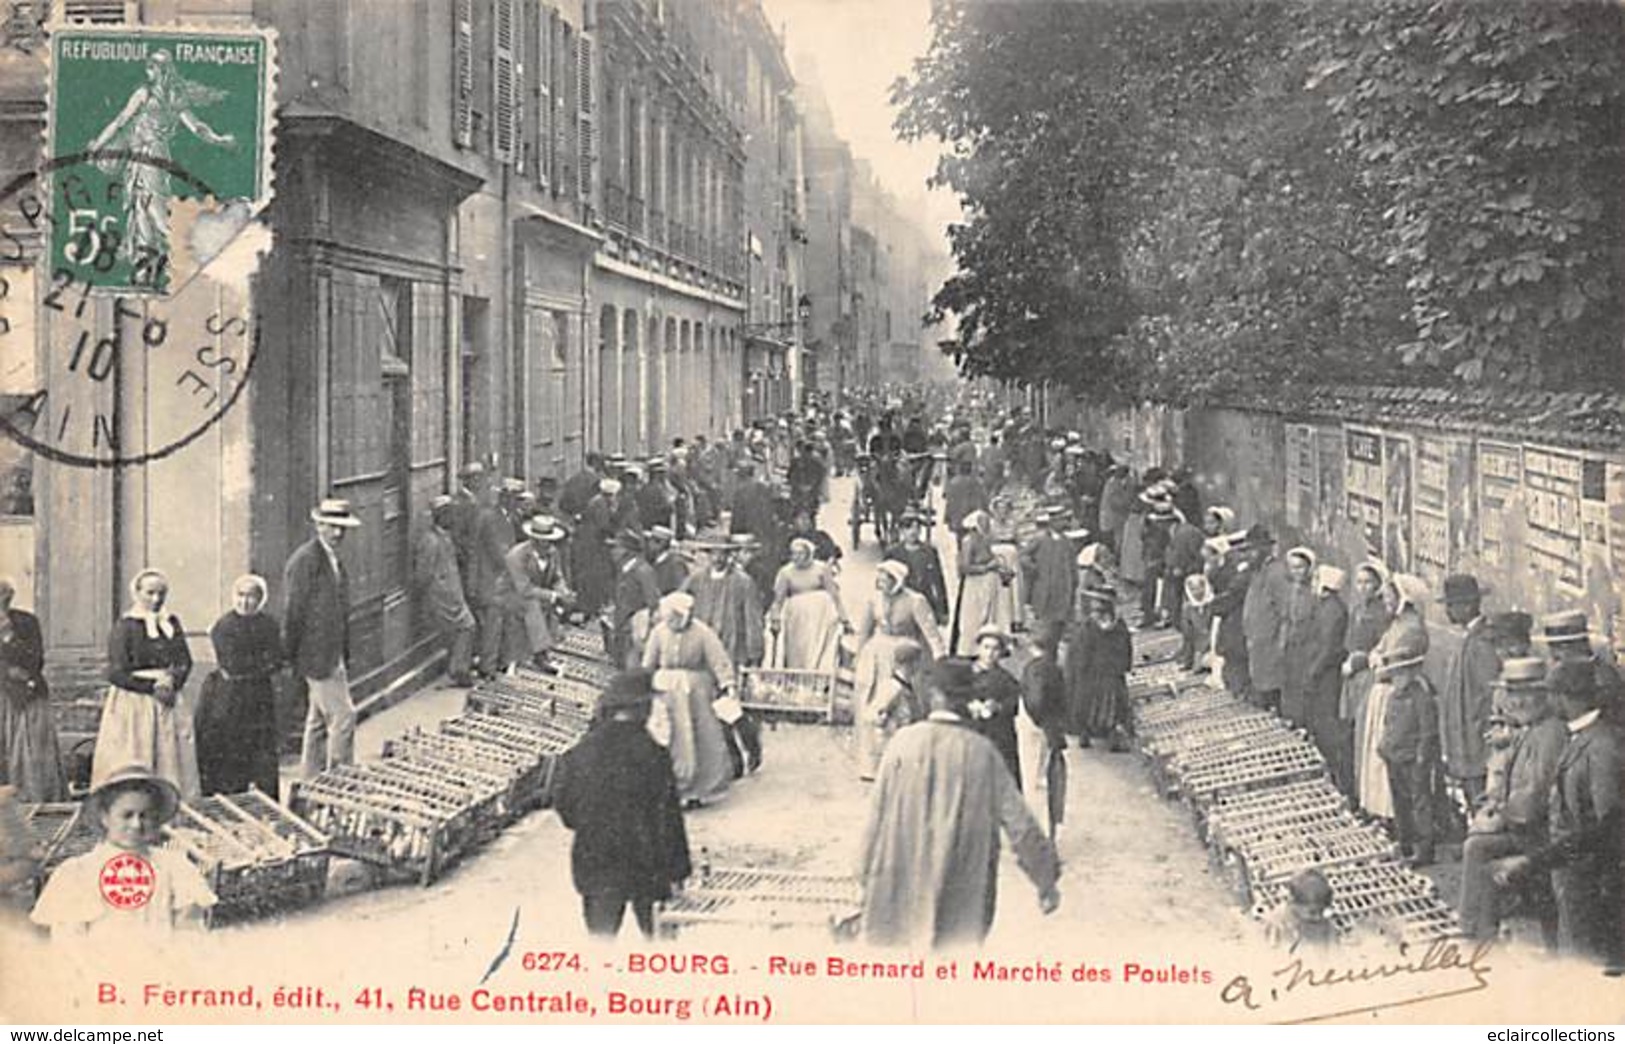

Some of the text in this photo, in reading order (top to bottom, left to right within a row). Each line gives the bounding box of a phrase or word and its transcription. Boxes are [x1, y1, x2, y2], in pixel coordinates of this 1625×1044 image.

[175, 43, 256, 65] FRANÇAISE
[68, 330, 116, 382] 10
[16, 388, 118, 450] AIN
